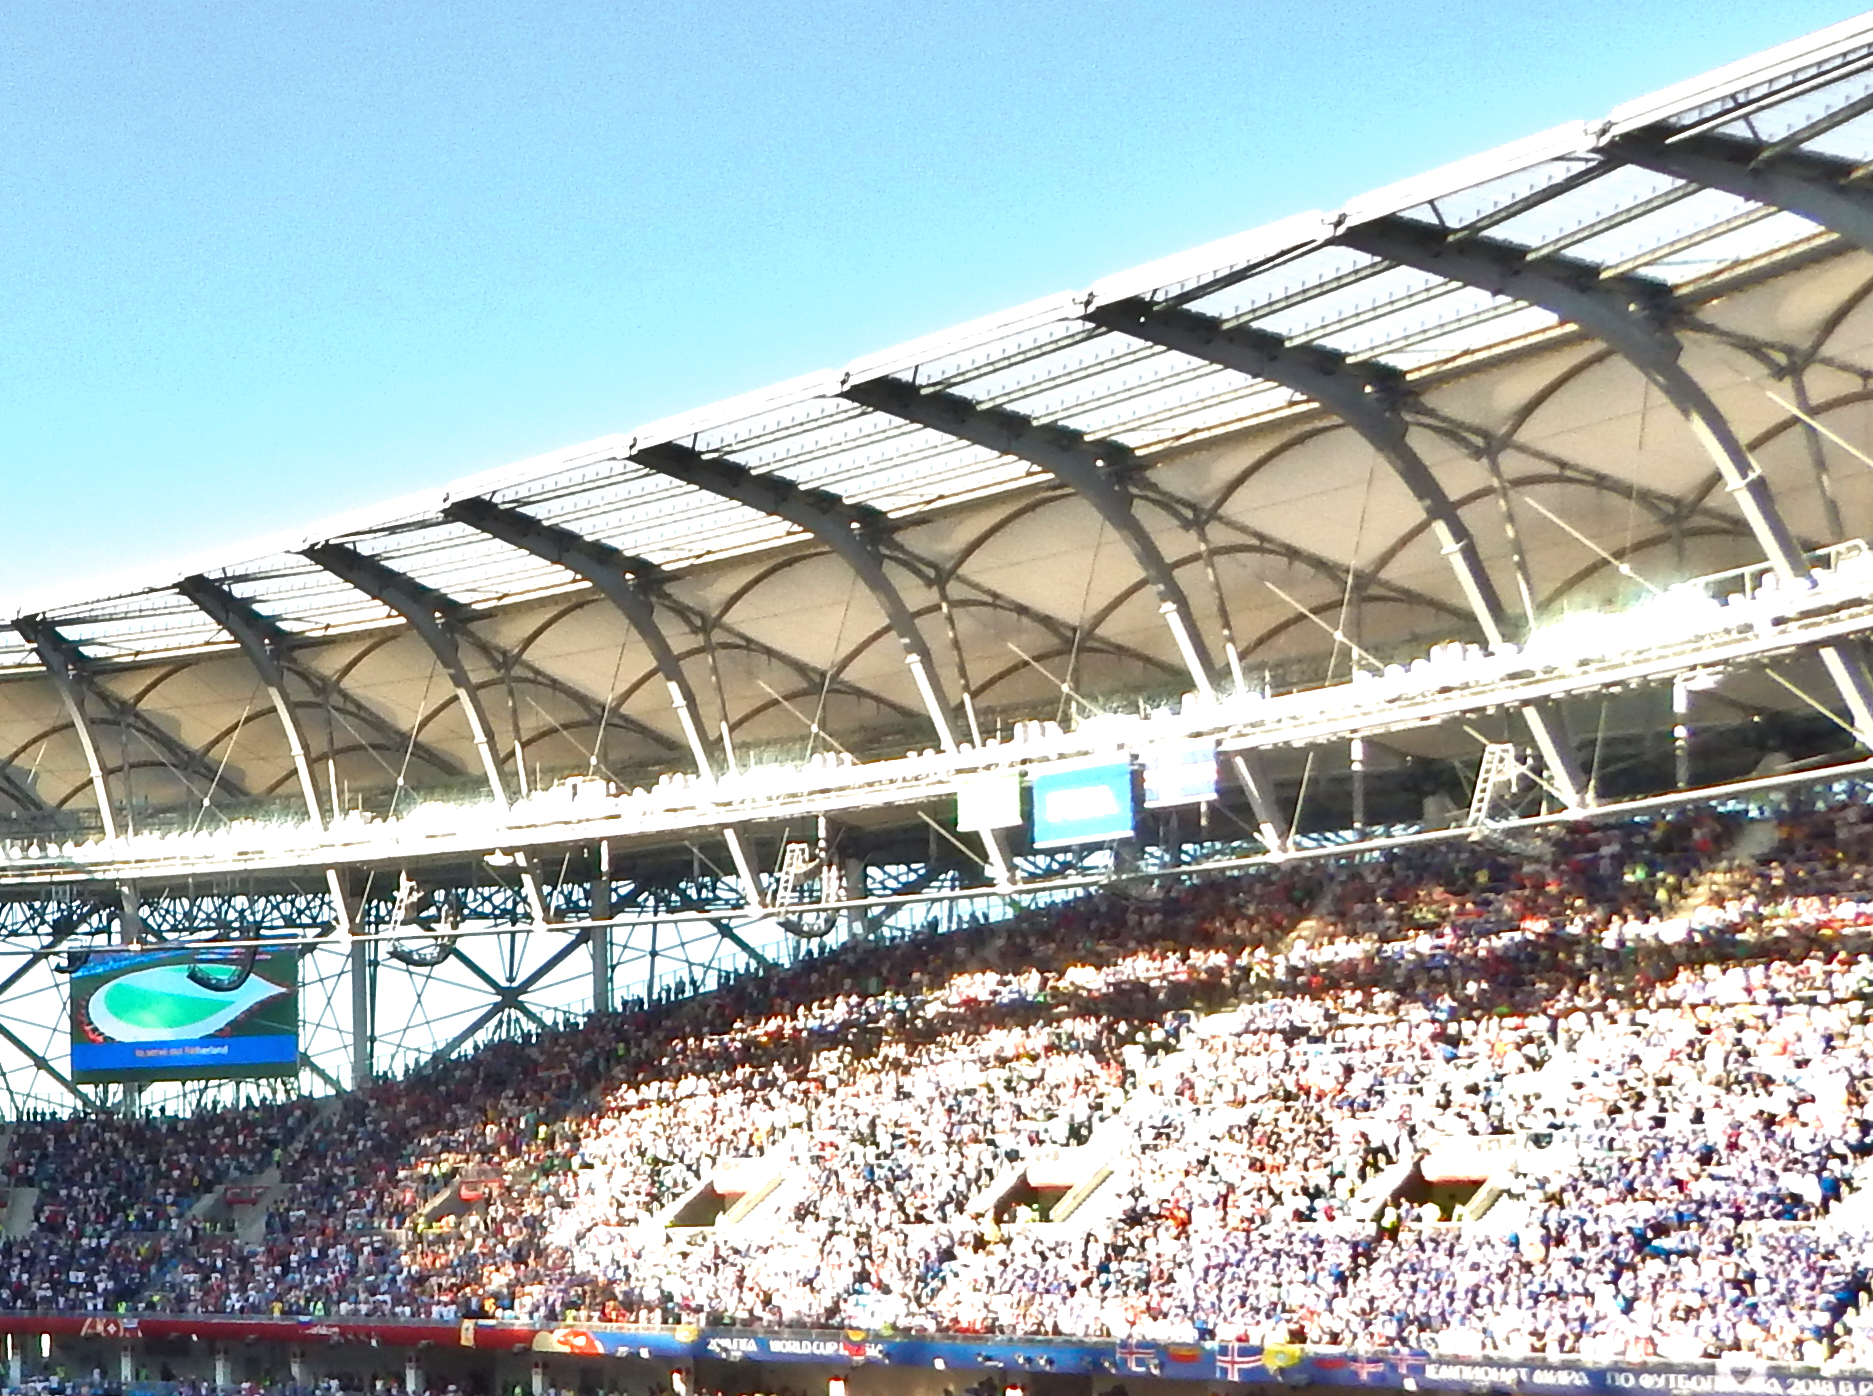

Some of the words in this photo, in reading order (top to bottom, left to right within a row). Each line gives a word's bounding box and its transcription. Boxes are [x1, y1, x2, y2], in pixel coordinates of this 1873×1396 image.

[769, 1340, 811, 1353] WORLD
[812, 1341, 838, 1355] CUP
[1606, 1371, 1635, 1388] ПО
[1639, 1372, 1716, 1392] ФУТБОЛ
[1787, 1376, 1834, 1396] 2018
